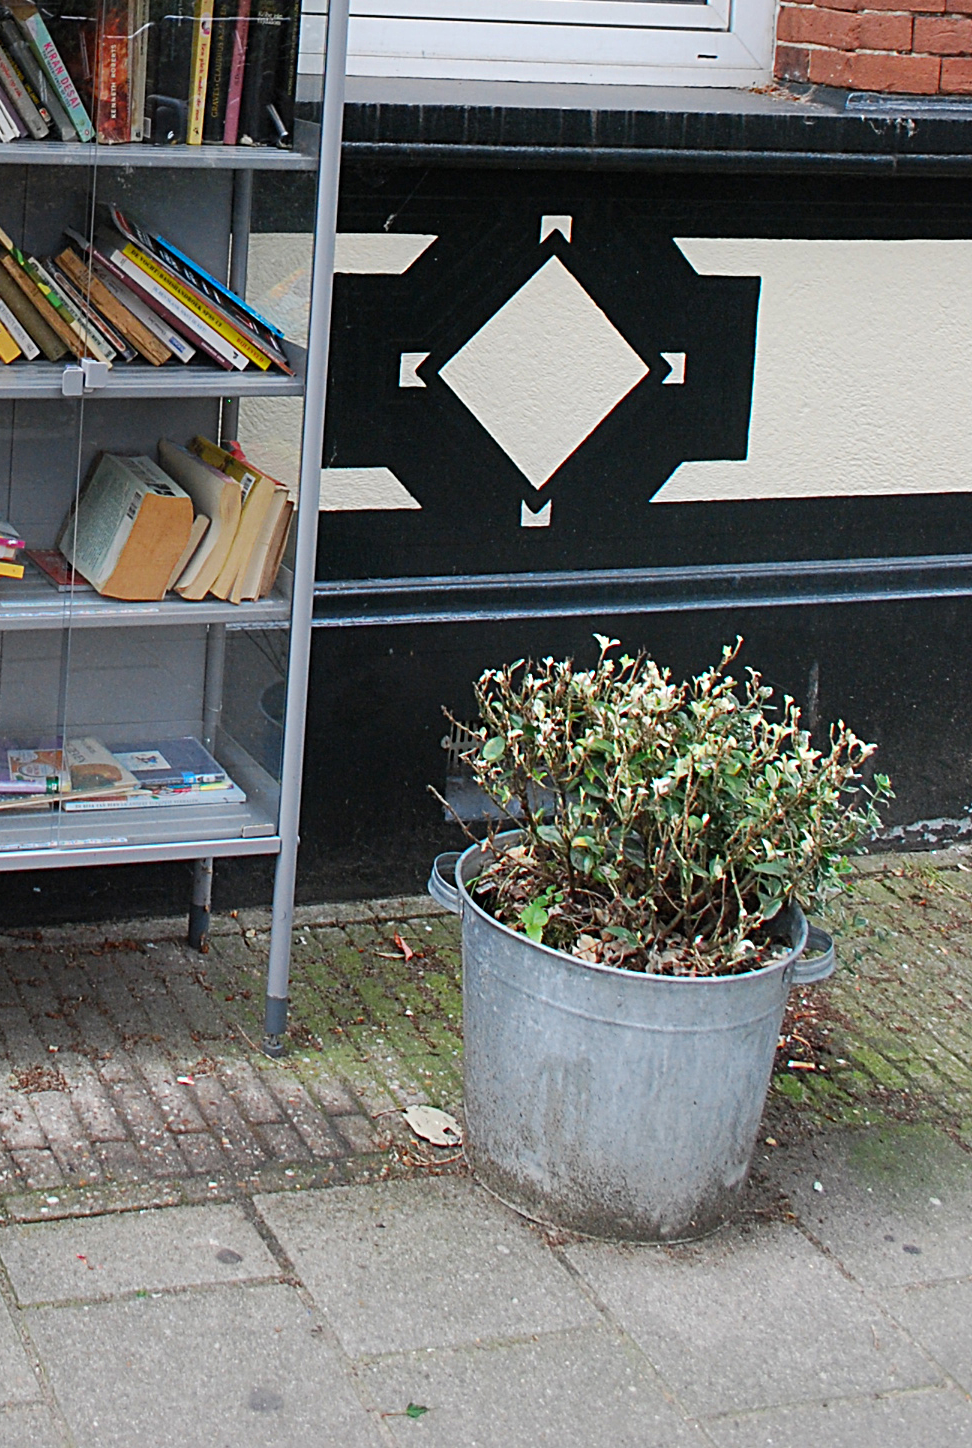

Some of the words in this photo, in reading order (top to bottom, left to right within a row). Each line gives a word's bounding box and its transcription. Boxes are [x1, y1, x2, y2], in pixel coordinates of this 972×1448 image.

[43, 42, 63, 75] KIRAN
[60, 76, 80, 109] DESAI
[130, 249, 140, 258] DE
